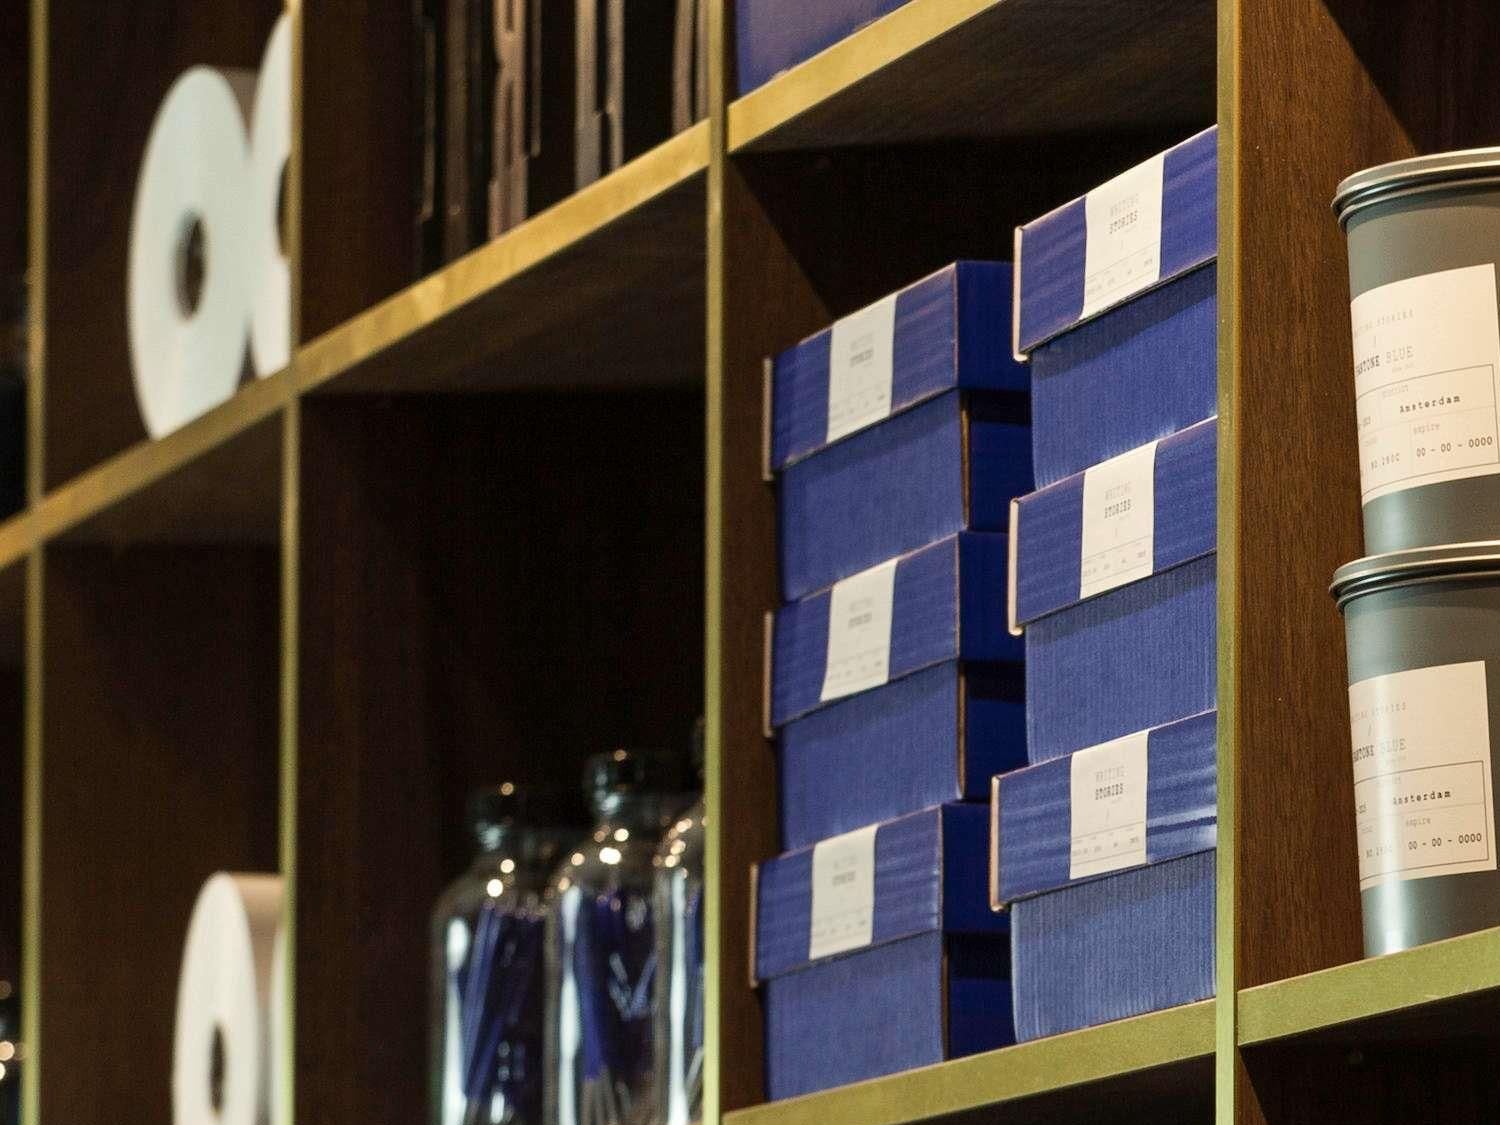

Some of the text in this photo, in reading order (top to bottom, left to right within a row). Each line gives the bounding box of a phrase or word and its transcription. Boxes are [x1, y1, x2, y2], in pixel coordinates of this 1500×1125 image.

[1385, 346, 1414, 364] BLUE
[1399, 395, 1461, 414] Amsterdam
[1393, 791, 1451, 806] Amsterdam
